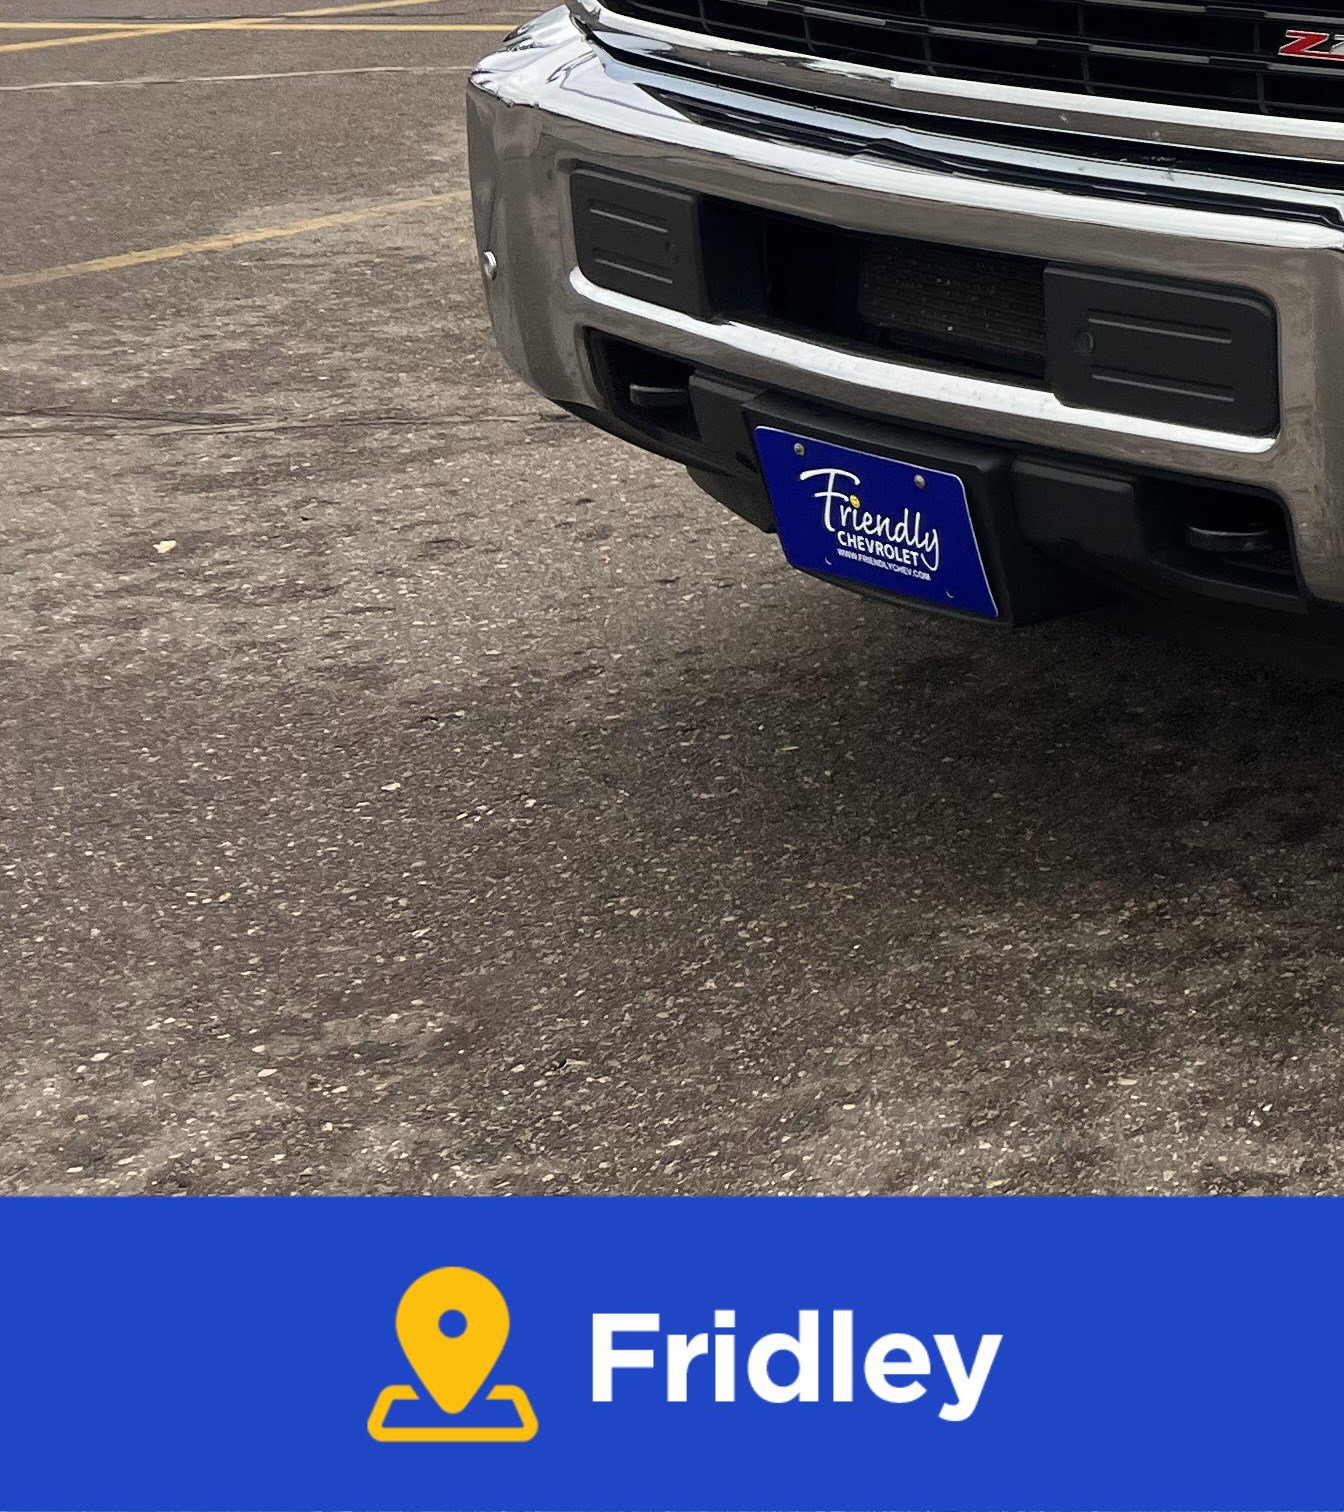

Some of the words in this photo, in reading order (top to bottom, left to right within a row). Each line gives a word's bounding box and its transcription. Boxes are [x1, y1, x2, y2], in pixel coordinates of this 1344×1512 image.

[799, 467, 941, 572] Friendly
[836, 529, 921, 567] CHEVROLET
[836, 548, 932, 581] WWW.FRIENDLYCHEV.COM
